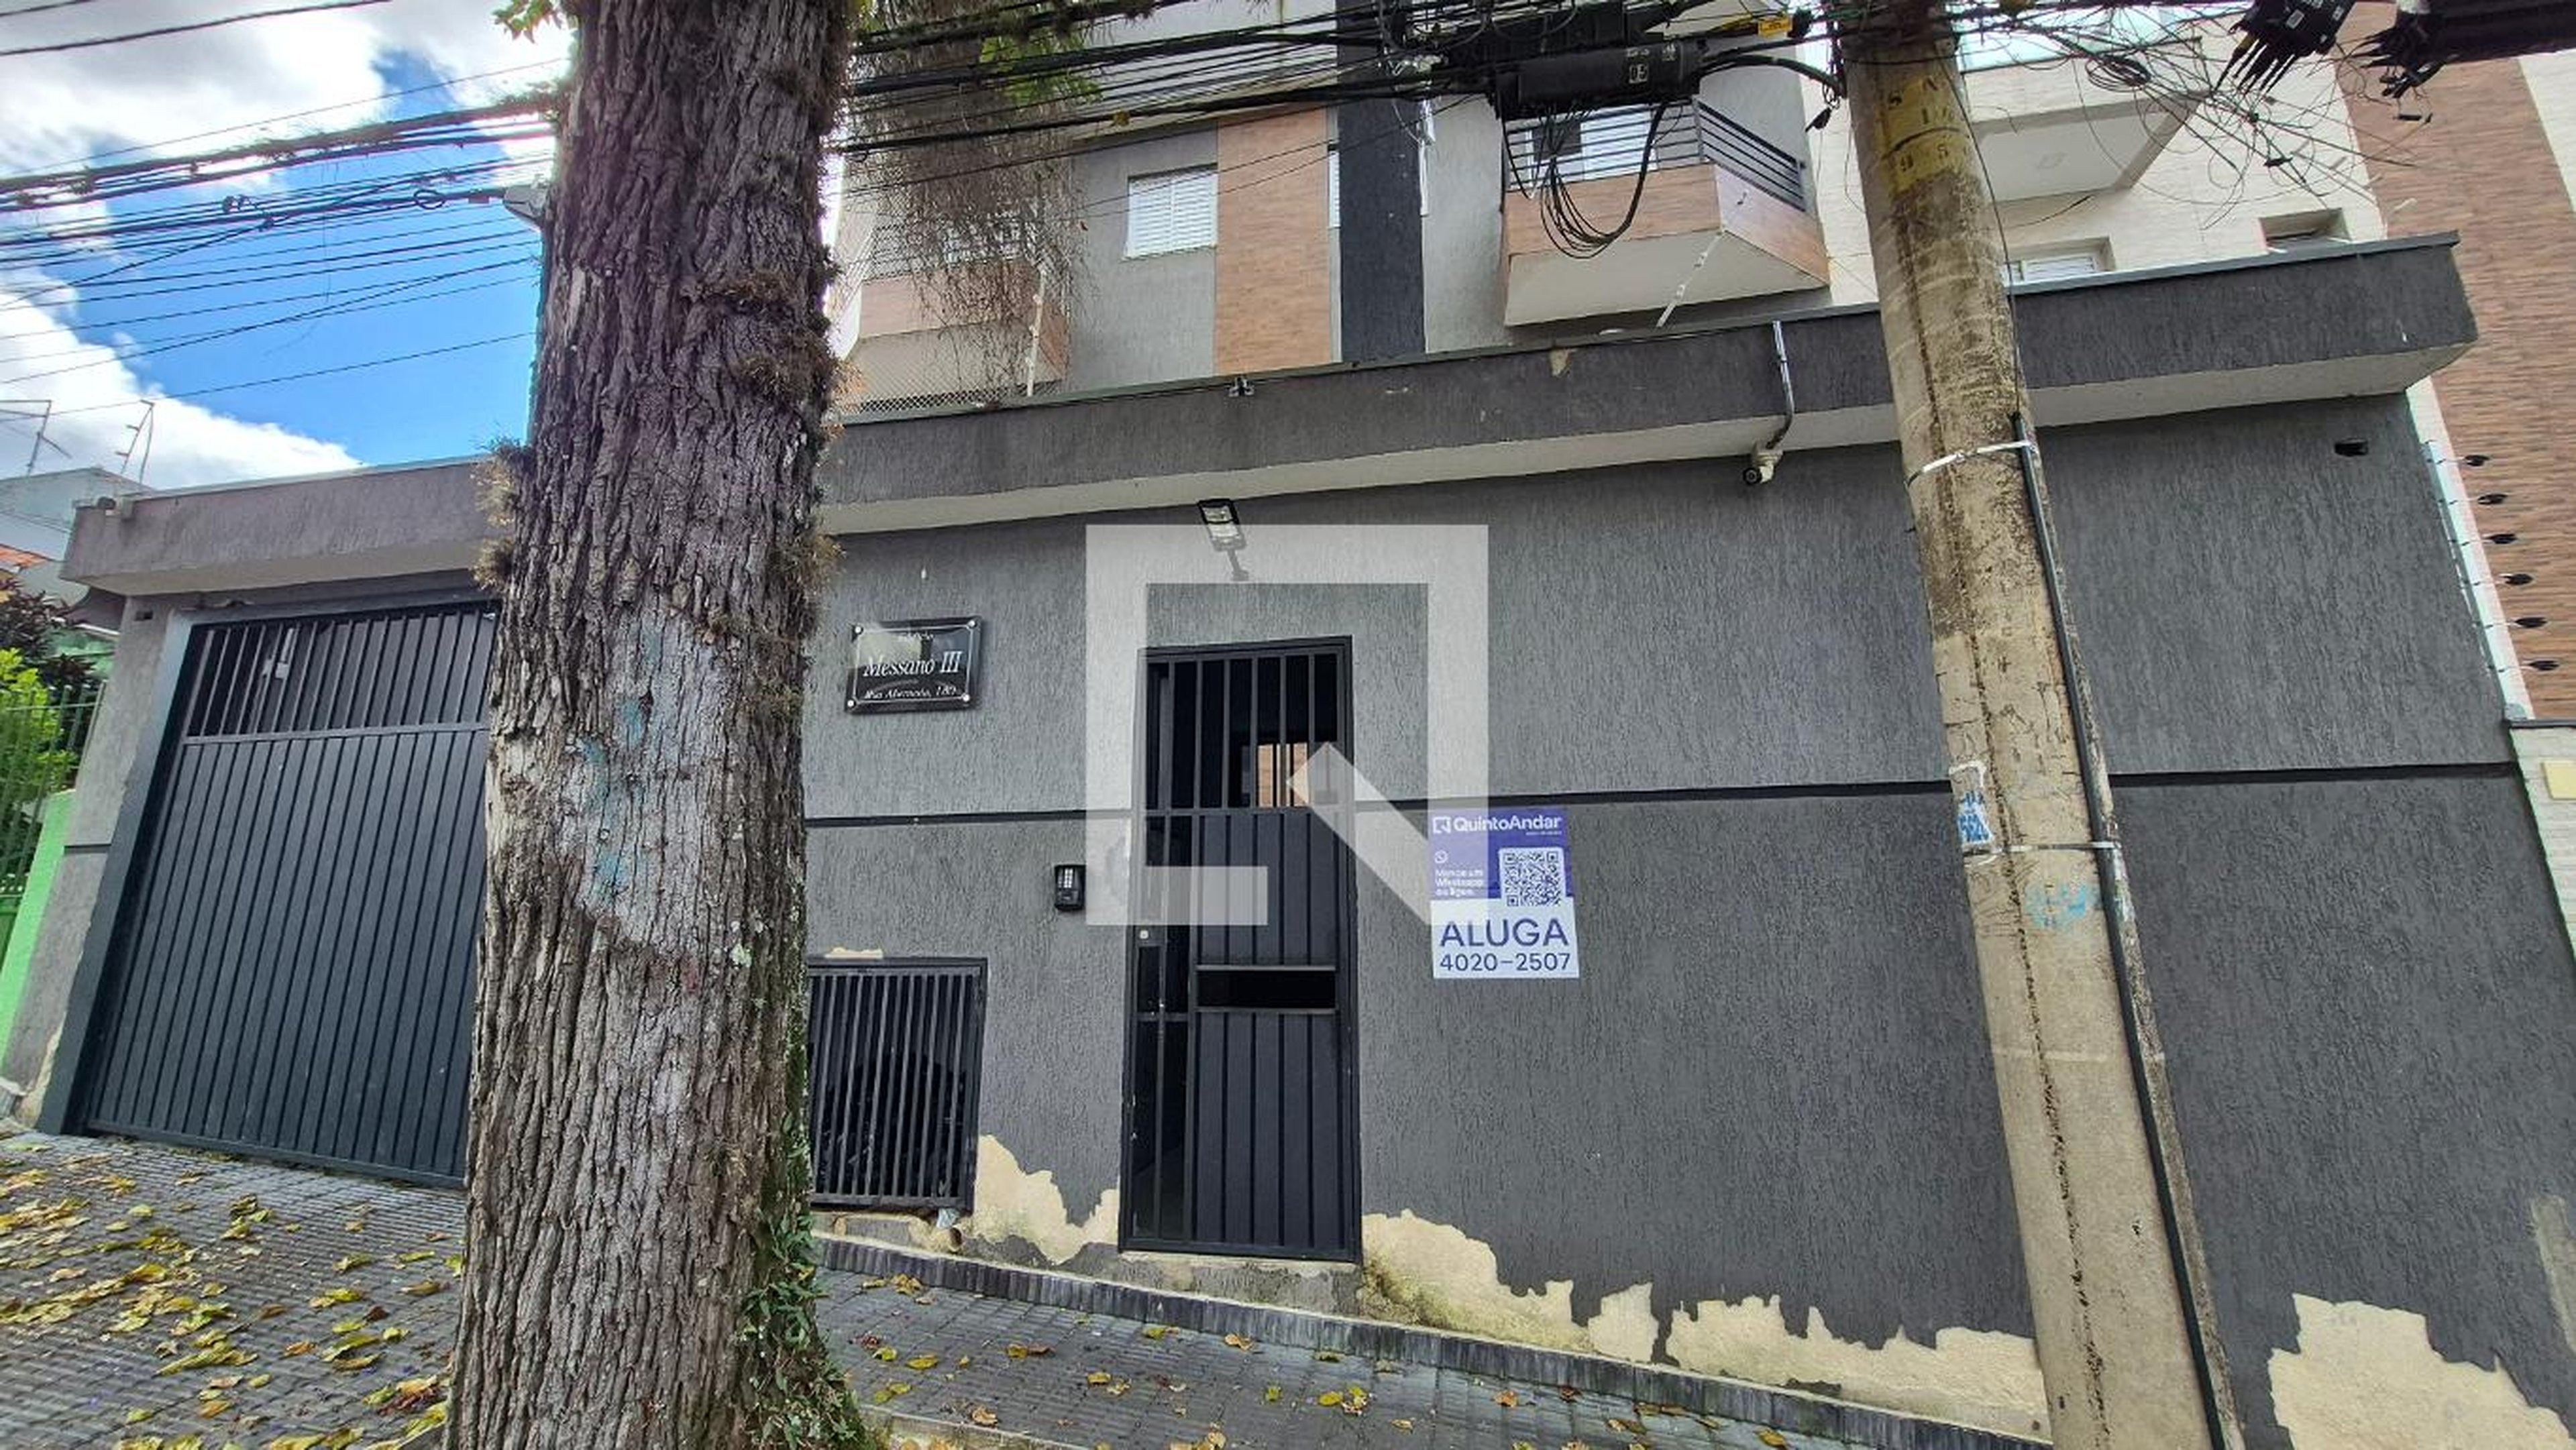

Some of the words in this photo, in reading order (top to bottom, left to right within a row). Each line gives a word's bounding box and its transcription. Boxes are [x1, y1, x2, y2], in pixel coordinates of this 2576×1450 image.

[940, 651, 963, 673] III
[1453, 815, 1562, 832] QuintoAndar
[1440, 918, 1568, 947] ALUGA
[1440, 952, 1571, 972] 4020-2507
